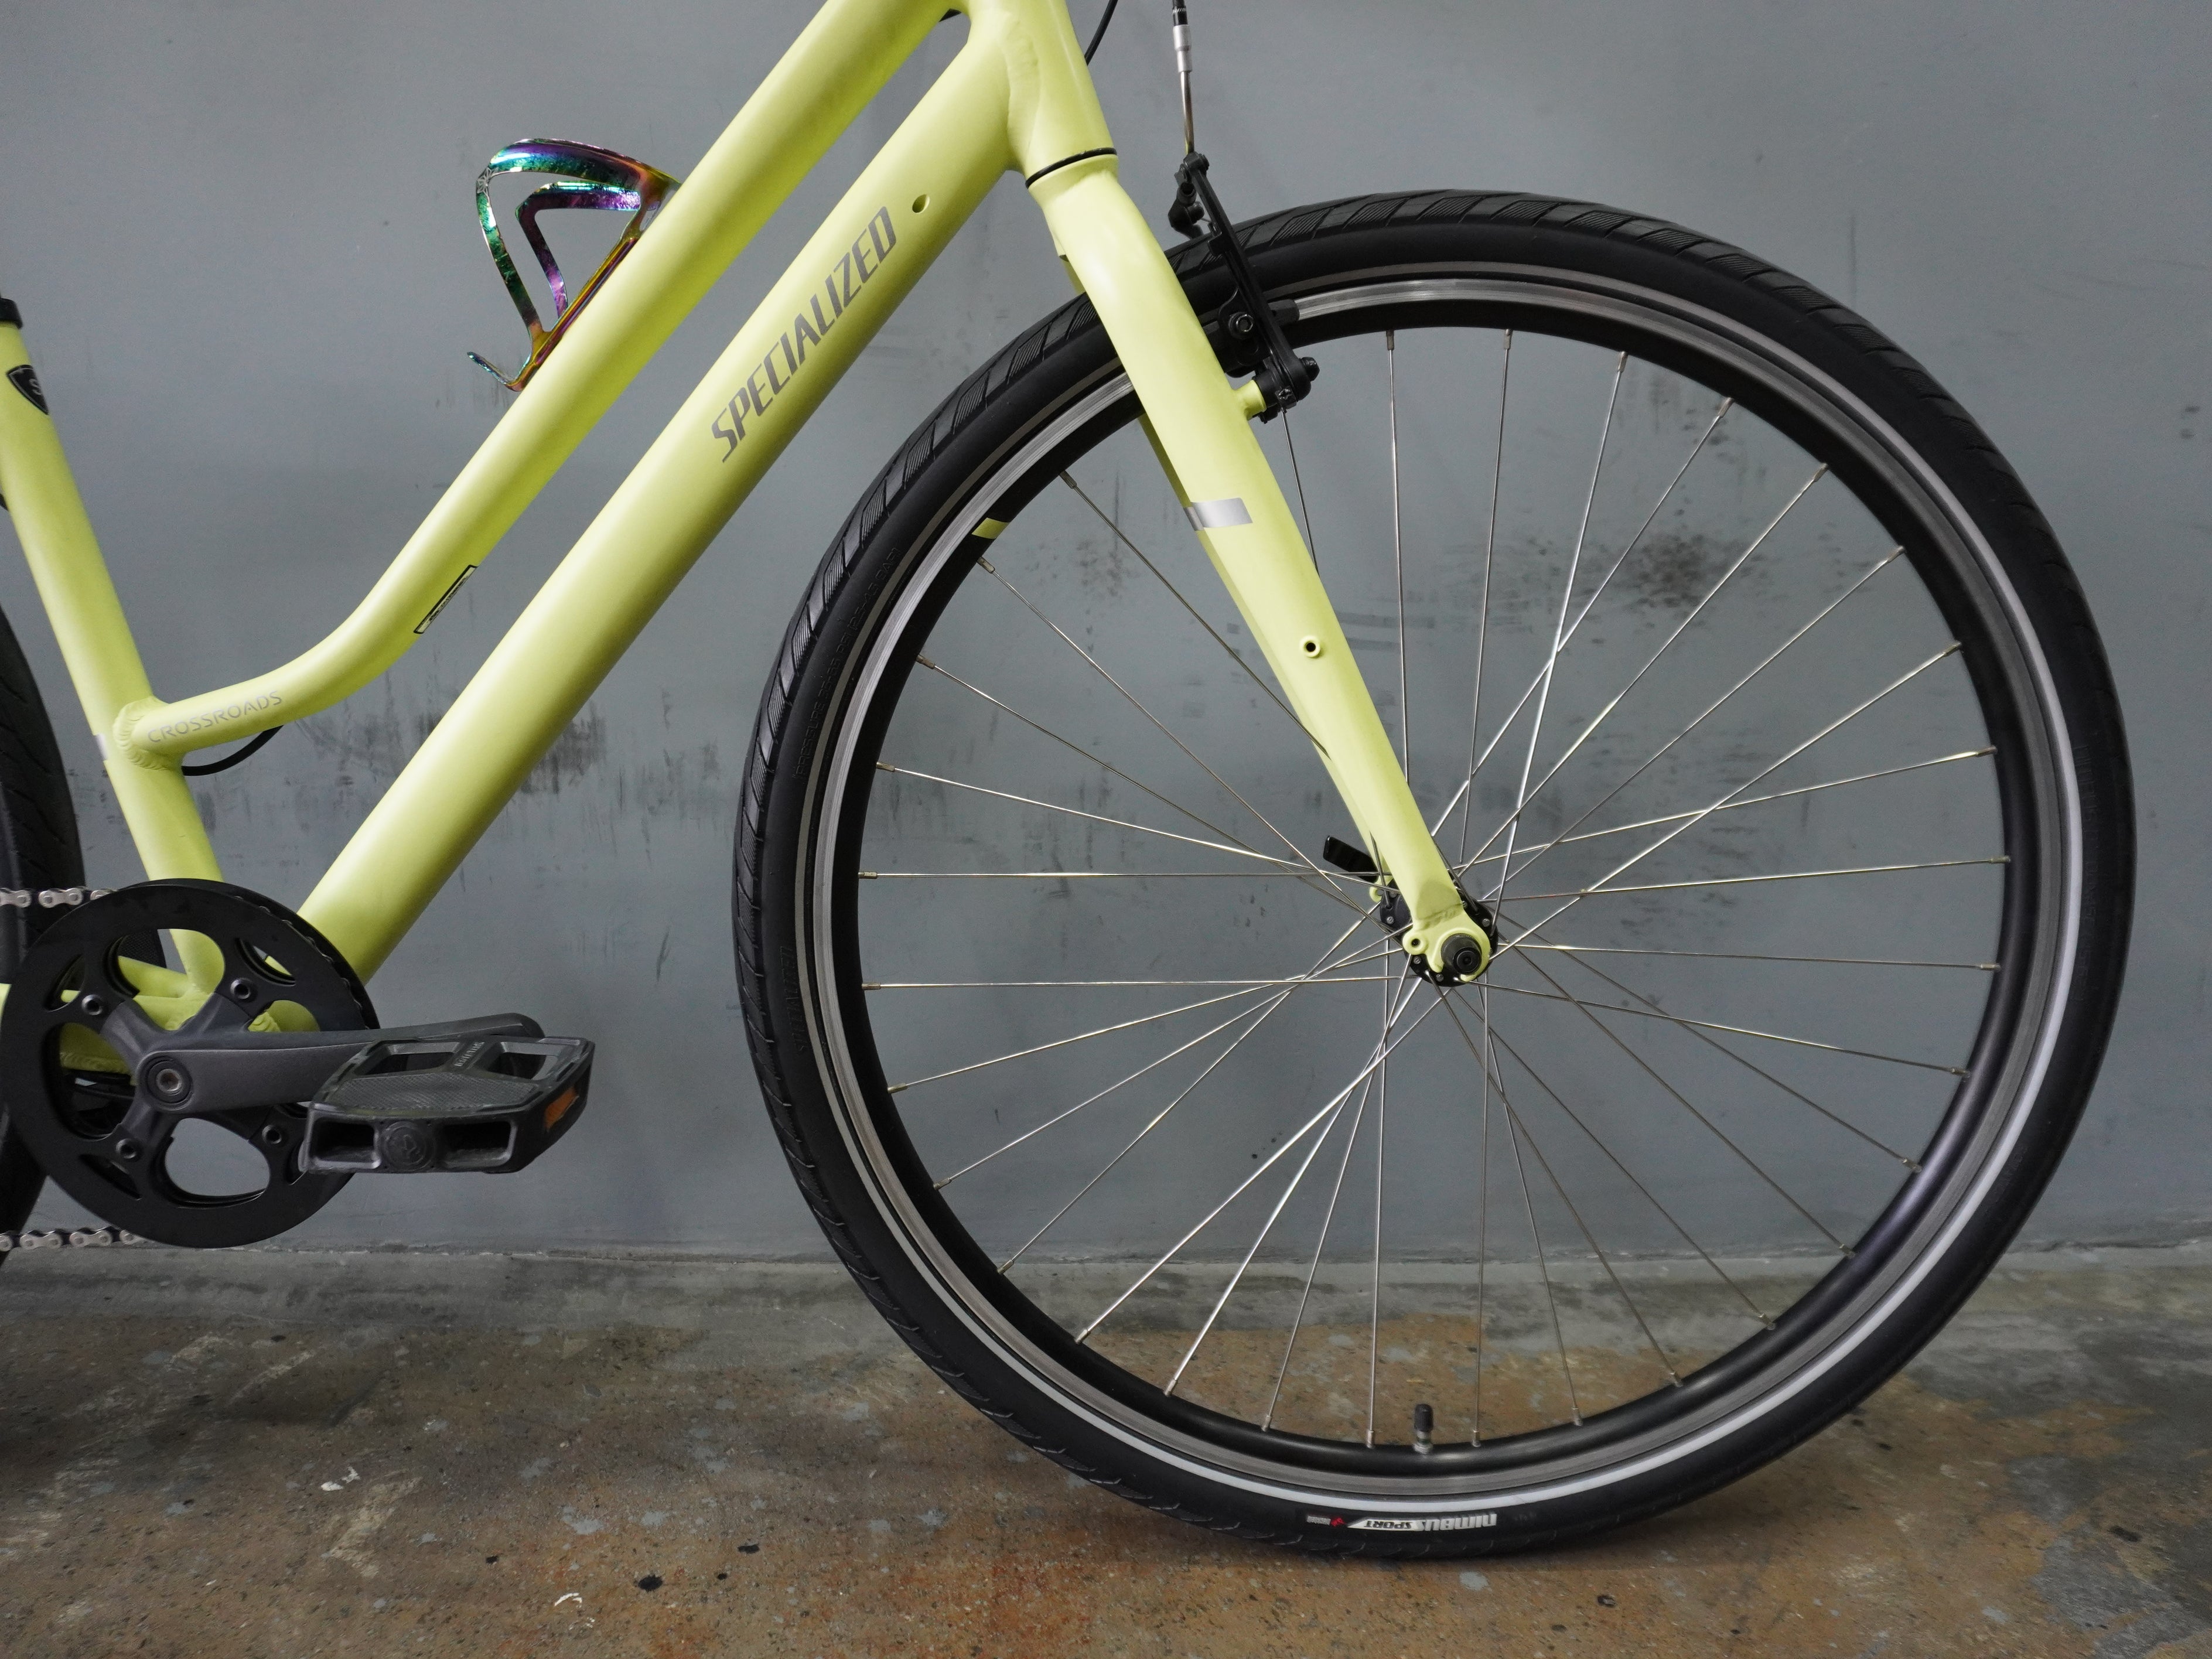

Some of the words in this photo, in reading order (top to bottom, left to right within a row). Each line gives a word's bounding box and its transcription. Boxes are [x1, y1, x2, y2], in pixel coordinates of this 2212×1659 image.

[711, 206, 896, 463] SPECIALIZED
[148, 690, 282, 743] CROSSROADS
[1364, 1520, 1412, 1530] SPORT
